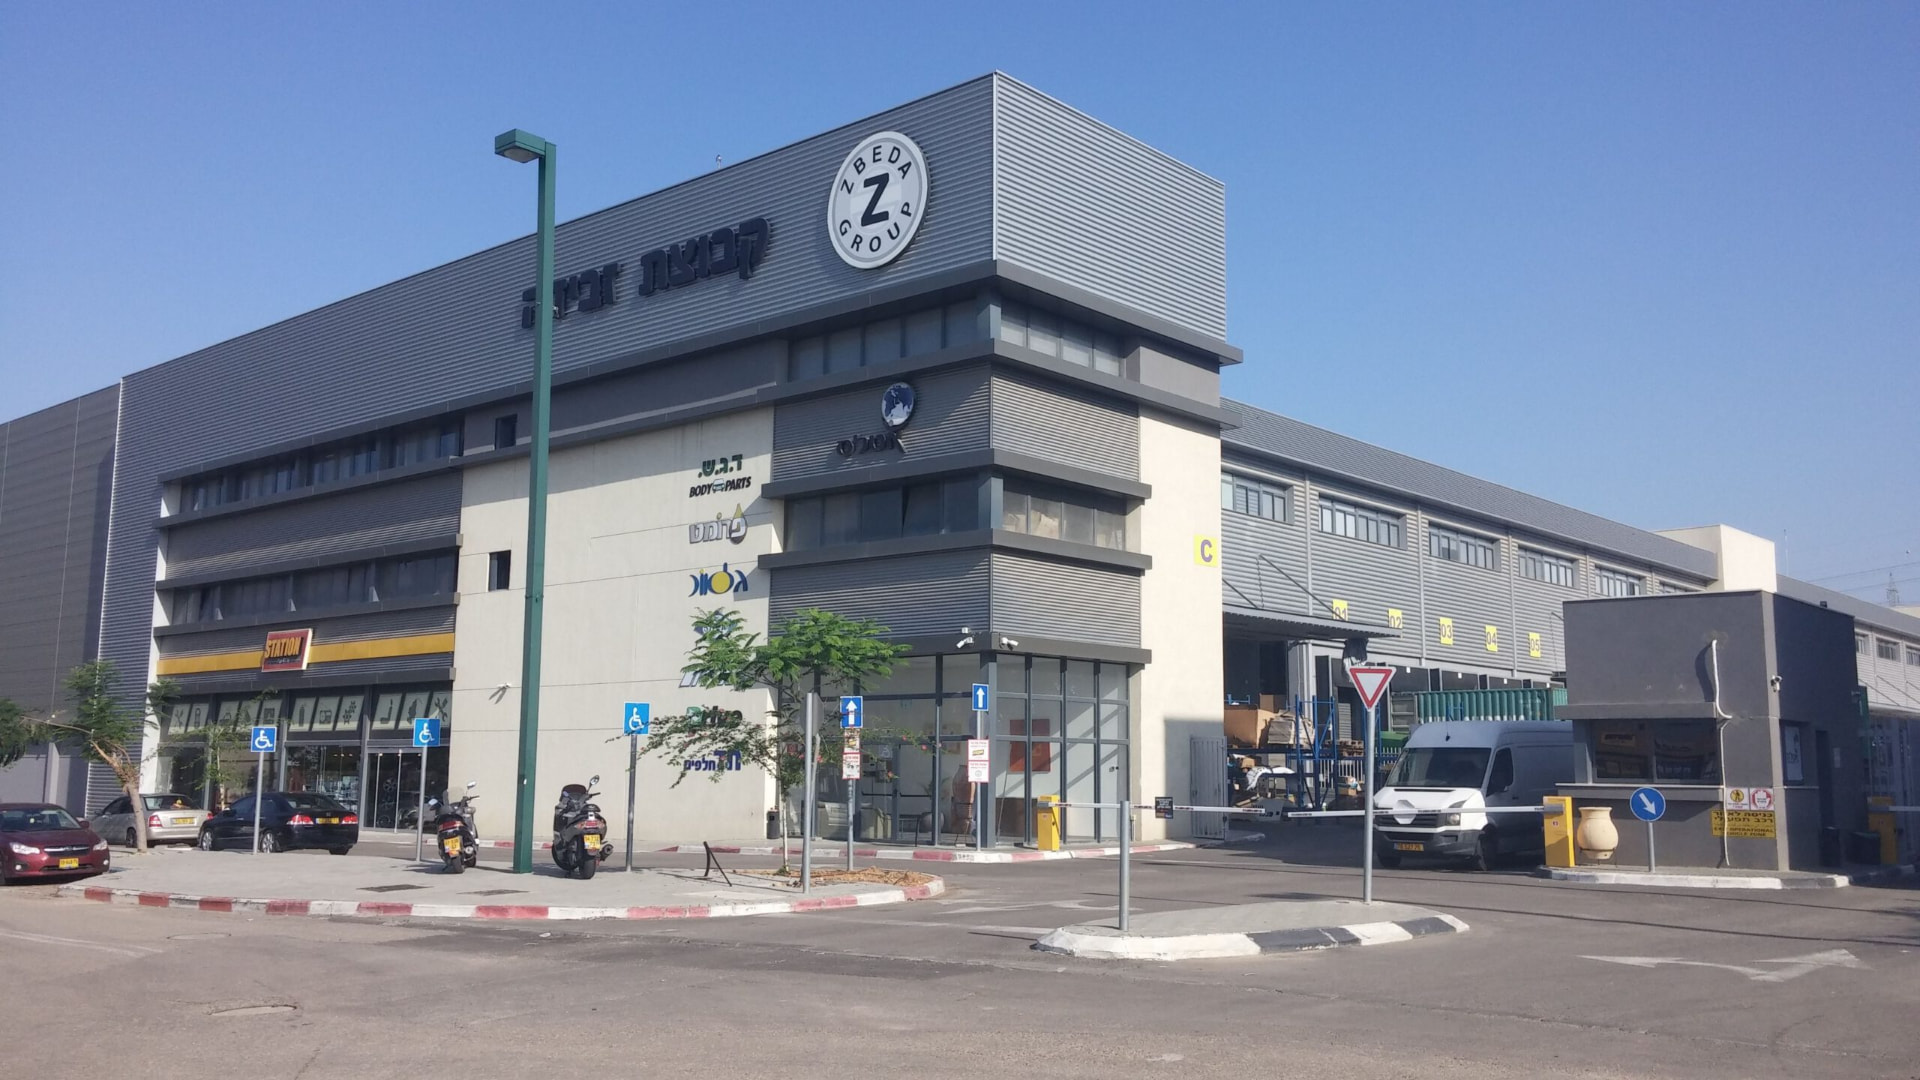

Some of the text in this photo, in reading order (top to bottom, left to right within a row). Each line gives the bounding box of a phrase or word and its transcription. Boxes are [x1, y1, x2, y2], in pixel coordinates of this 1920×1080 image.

[840, 145, 912, 195] ZBEDA
[860, 172, 890, 227] Z
[838, 201, 912, 252] GROUP
[638, 217, 771, 296] קבוצת
[689, 476, 752, 498] BODY PARTS
[1200, 539, 1213, 563] C
[1389, 615, 1402, 628] 02
[1440, 623, 1453, 639] 03
[264, 637, 301, 657] STATION
[1486, 631, 1498, 645] 04
[1529, 638, 1541, 652] 05
[683, 756, 716, 772] חלפים
